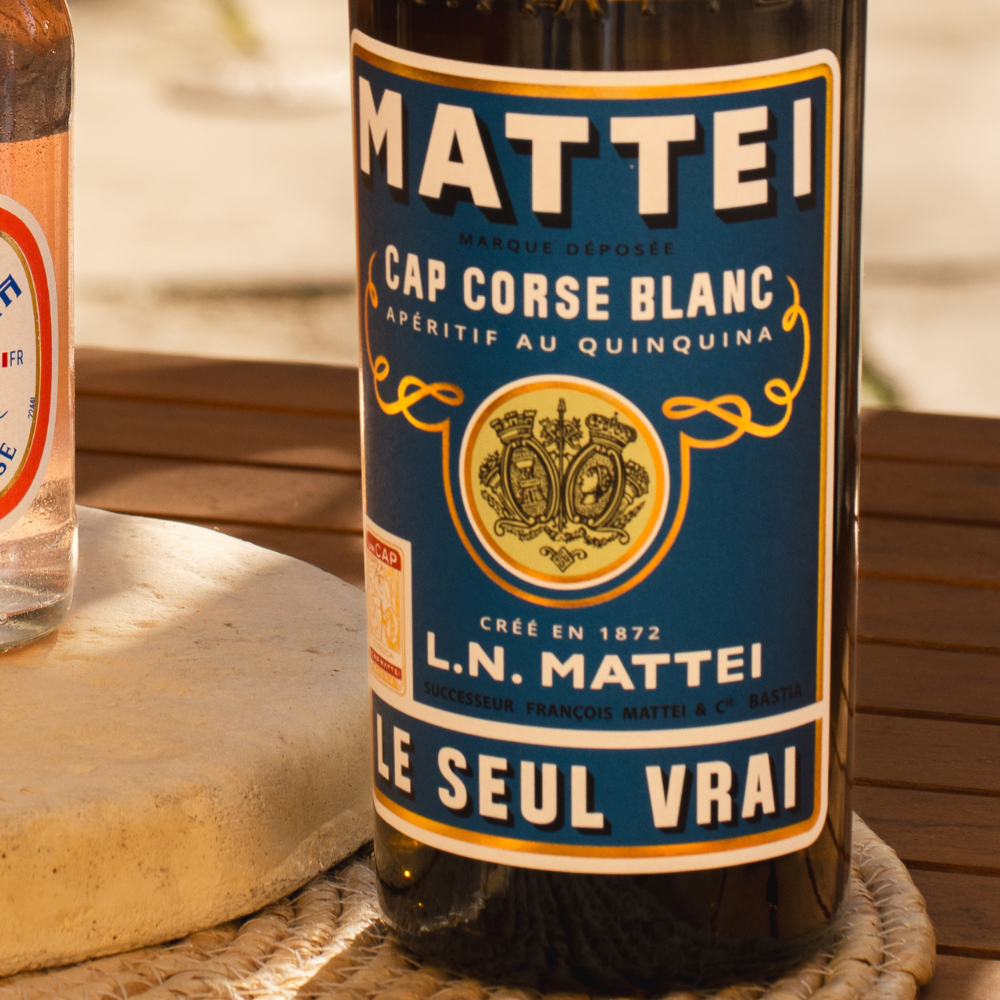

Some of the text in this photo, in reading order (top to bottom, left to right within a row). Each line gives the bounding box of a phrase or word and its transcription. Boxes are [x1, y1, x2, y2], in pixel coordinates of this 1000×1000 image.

[358, 75, 814, 217] MATTEI
[459, 231, 674, 257] MARQUE DÉPOSÉE
[384, 244, 774, 321] CAP CORSE BLANC
[385, 306, 772, 357] APÉRITIF AU QUINQUINA
[9, 350, 24, 367] FR
[479, 616, 662, 641] CRÉÉ EN 1872
[427, 631, 522, 685] L.N.
[541, 642, 762, 690] MATTEI
[423, 681, 514, 713] SUCCESSEUR
[526, 701, 614, 722] FRANÇOIS
[622, 704, 686, 720] MATTEI
[695, 702, 707, 717] &
[749, 683, 803, 709] BASTIA
[376, 713, 797, 829] LE SEUL VRAI
